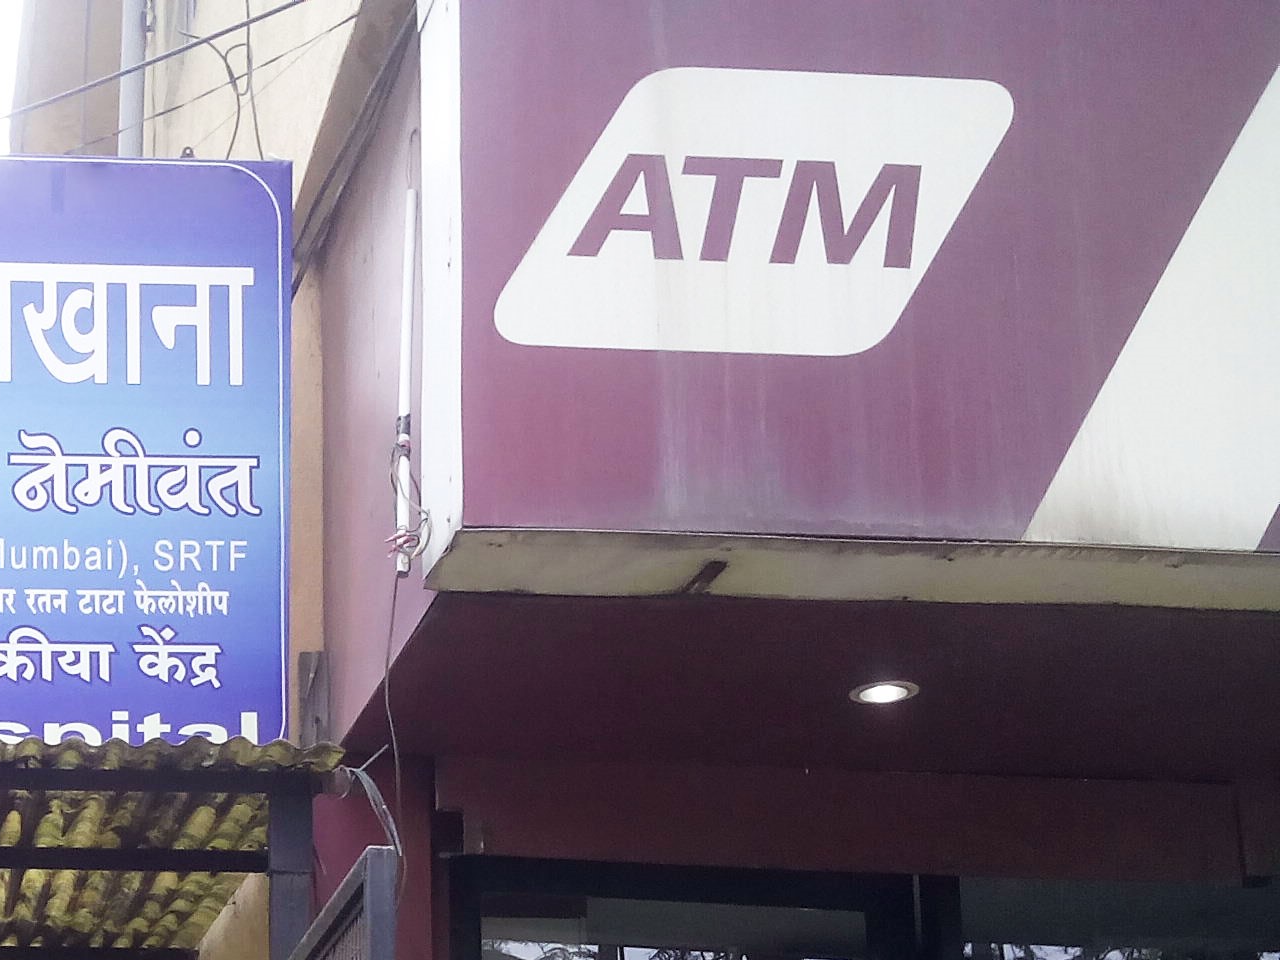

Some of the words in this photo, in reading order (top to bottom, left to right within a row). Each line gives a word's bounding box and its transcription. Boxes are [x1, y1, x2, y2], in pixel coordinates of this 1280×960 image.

[566, 152, 923, 270] ATM
[8, 426, 262, 517] नेमीवंत
[152, 539, 248, 573] SRTF
[24, 587, 68, 615] रतन
[75, 588, 125, 616] टाटा
[132, 578, 230, 618] फेलोशीप
[131, 624, 223, 689] केंद्र
